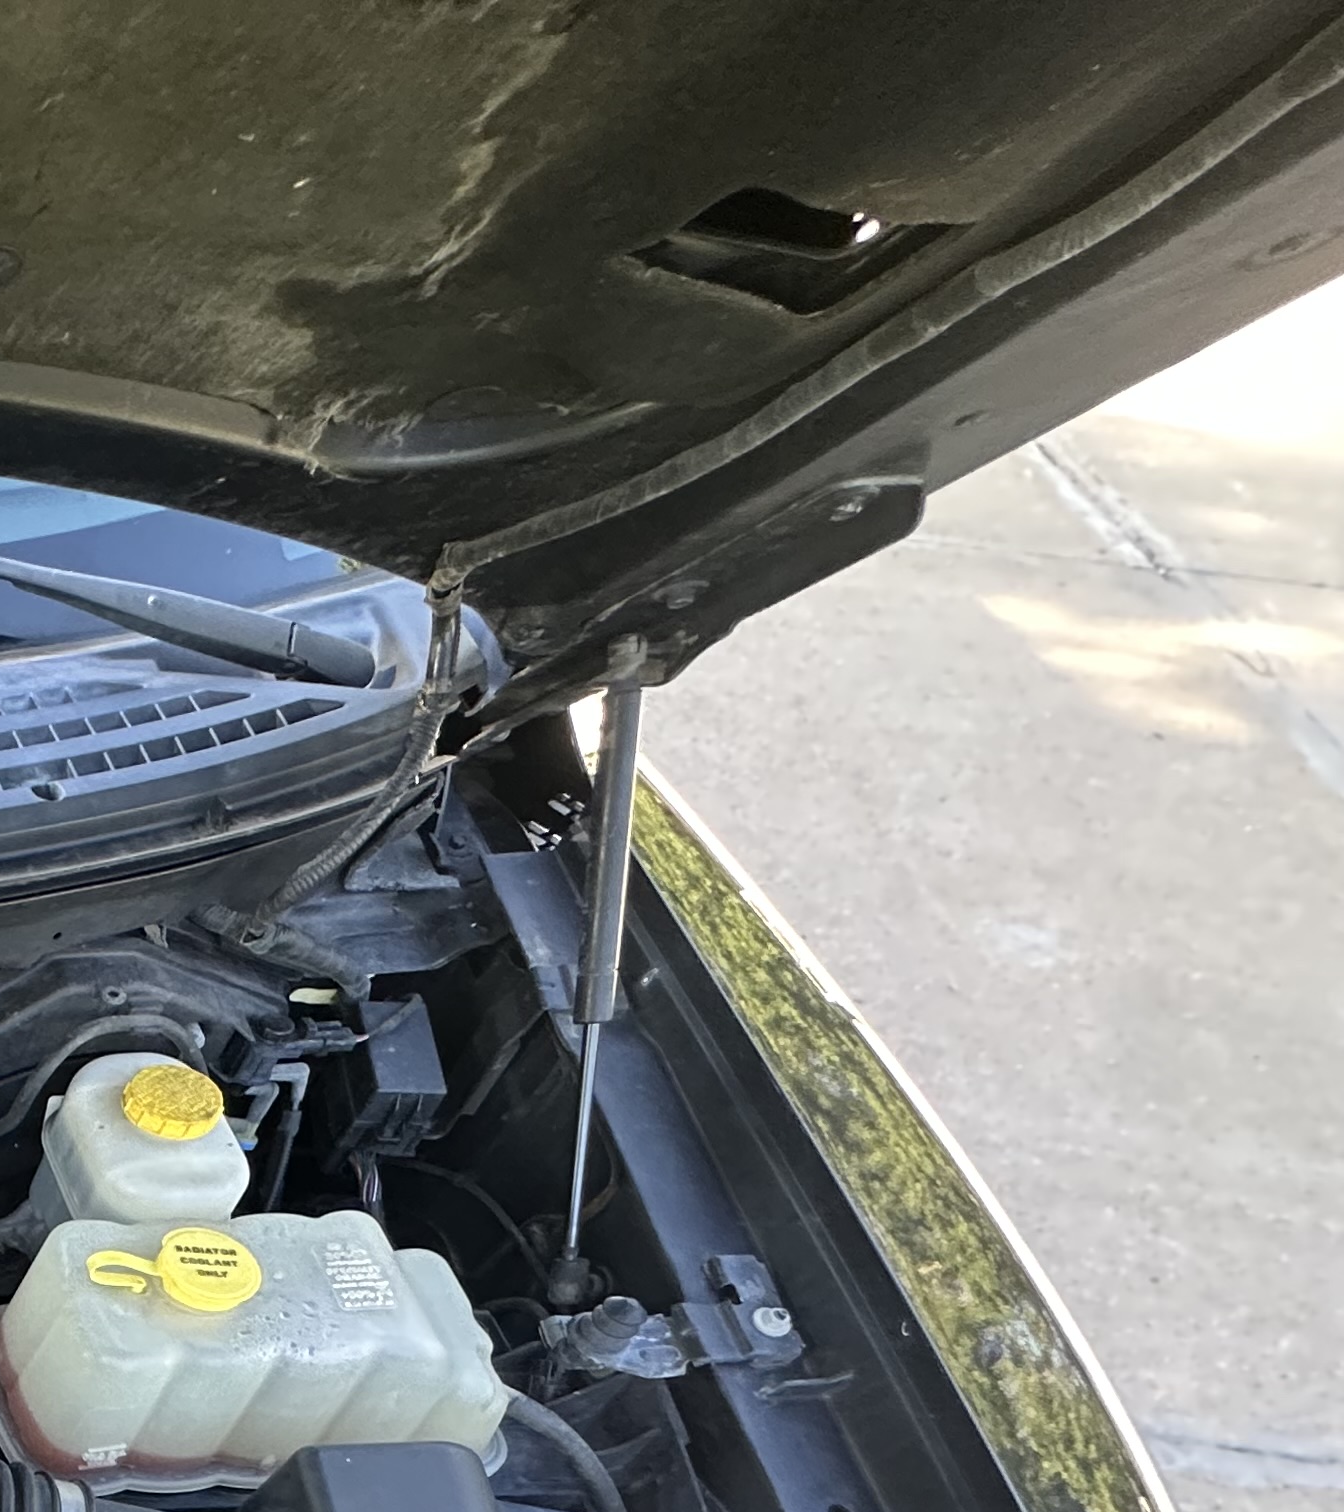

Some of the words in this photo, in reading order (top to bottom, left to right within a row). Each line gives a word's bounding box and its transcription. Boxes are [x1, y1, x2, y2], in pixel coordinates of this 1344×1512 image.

[174, 1244, 237, 1256] RADIATOR
[179, 1256, 238, 1268] COOLANT
[196, 1268, 229, 1279] ONLY
